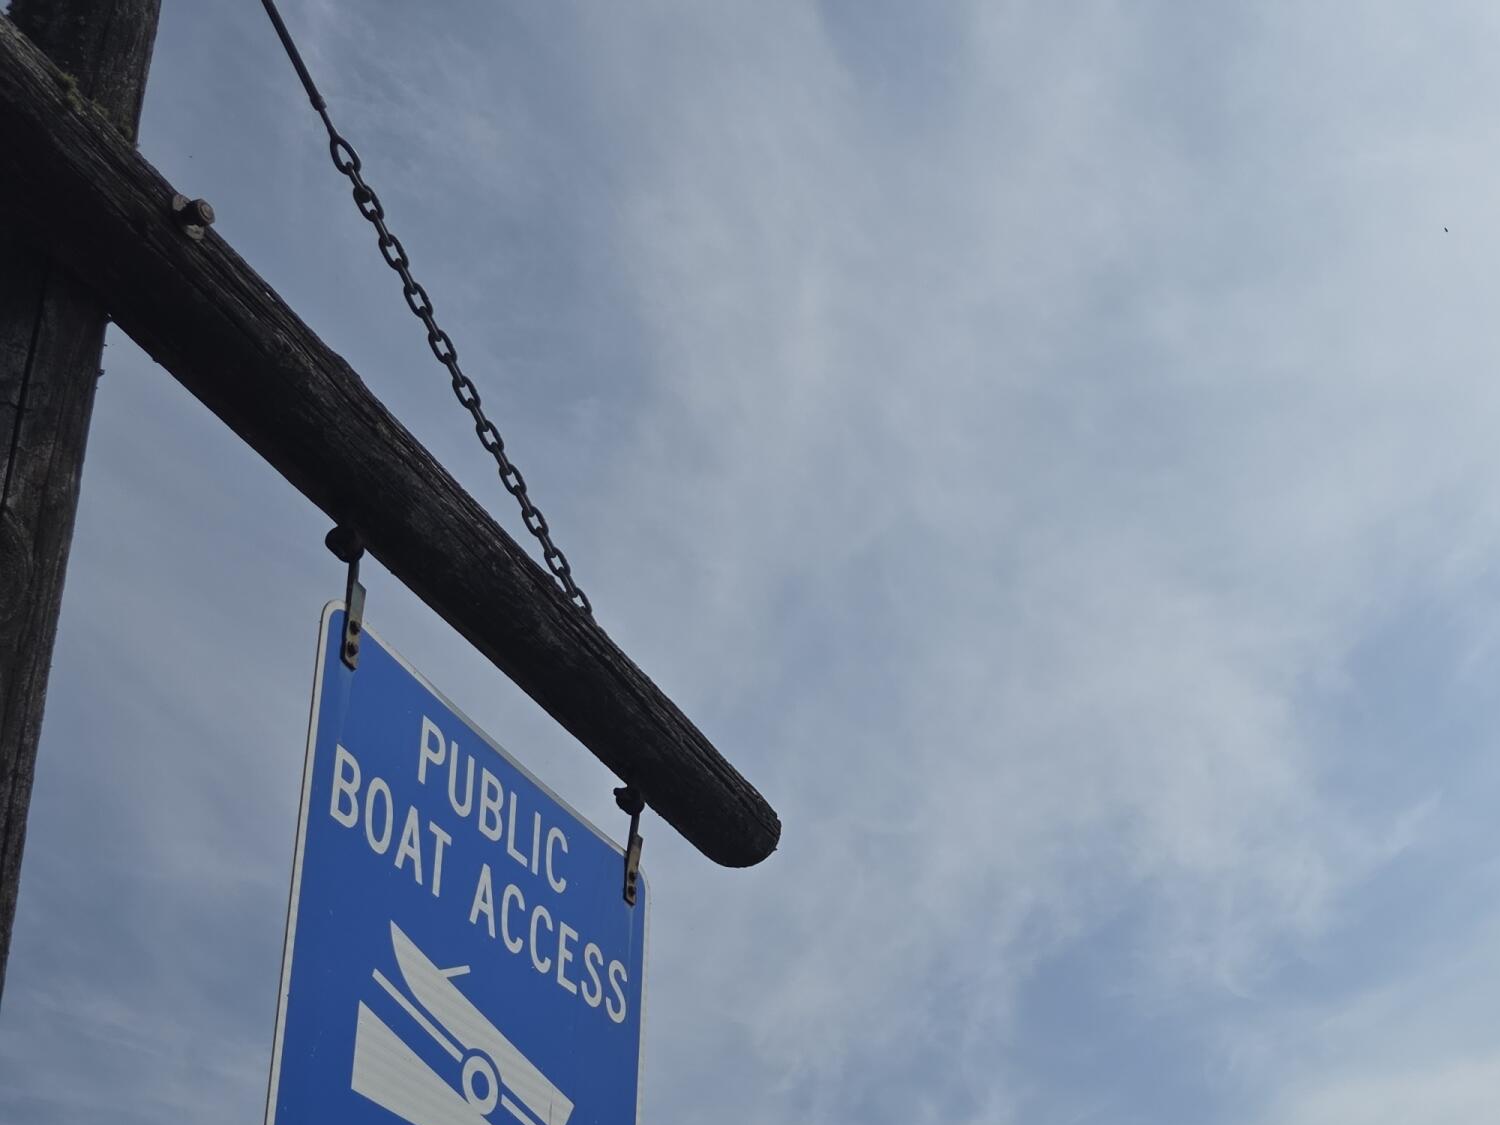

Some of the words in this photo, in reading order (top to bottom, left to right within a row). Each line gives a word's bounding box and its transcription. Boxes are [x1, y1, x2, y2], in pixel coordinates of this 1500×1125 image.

[330, 743, 452, 897] BOAT
[469, 863, 628, 1023] ACCESS
[418, 715, 568, 893] PUBLIC
